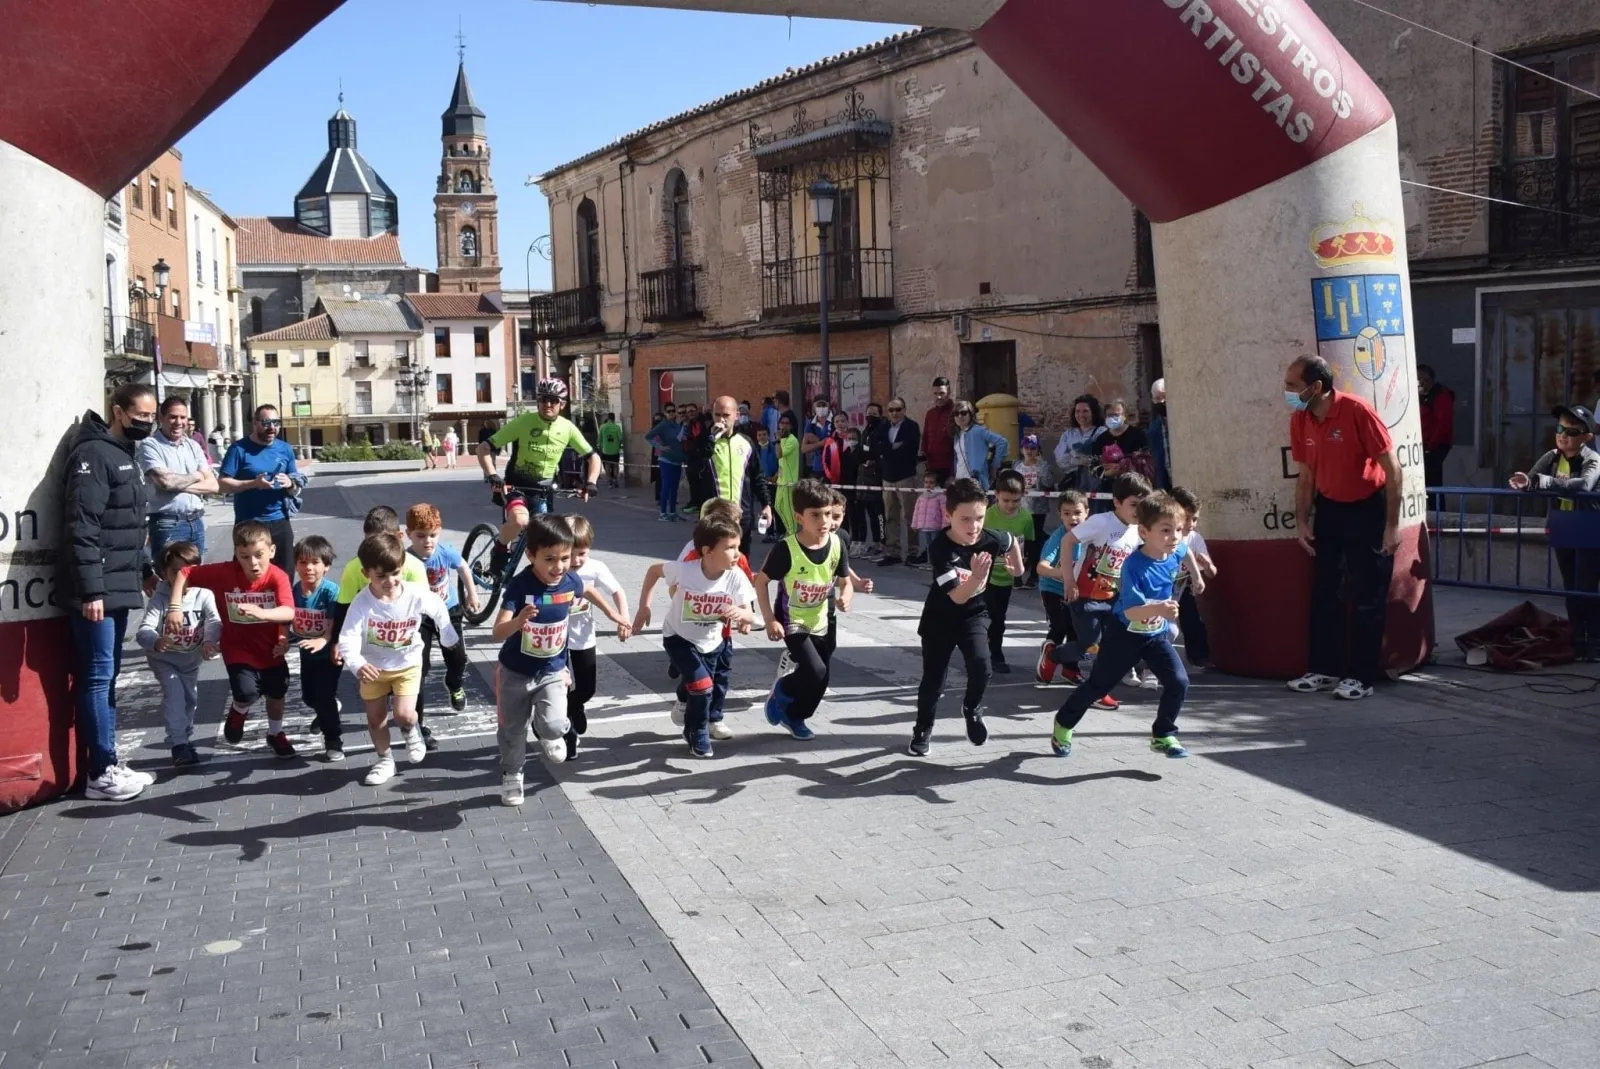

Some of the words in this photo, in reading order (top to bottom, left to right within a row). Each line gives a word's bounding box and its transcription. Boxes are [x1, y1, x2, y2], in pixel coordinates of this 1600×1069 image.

[1263, 504, 1296, 530] de
[226, 594, 275, 604] bedunia
[684, 591, 733, 605] bedunia
[799, 592, 826, 604] 370
[692, 602, 723, 615] 304
[296, 618, 323, 631] 295
[368, 617, 417, 630] bedunia
[376, 629, 407, 643] 302
[532, 633, 563, 649] 316
